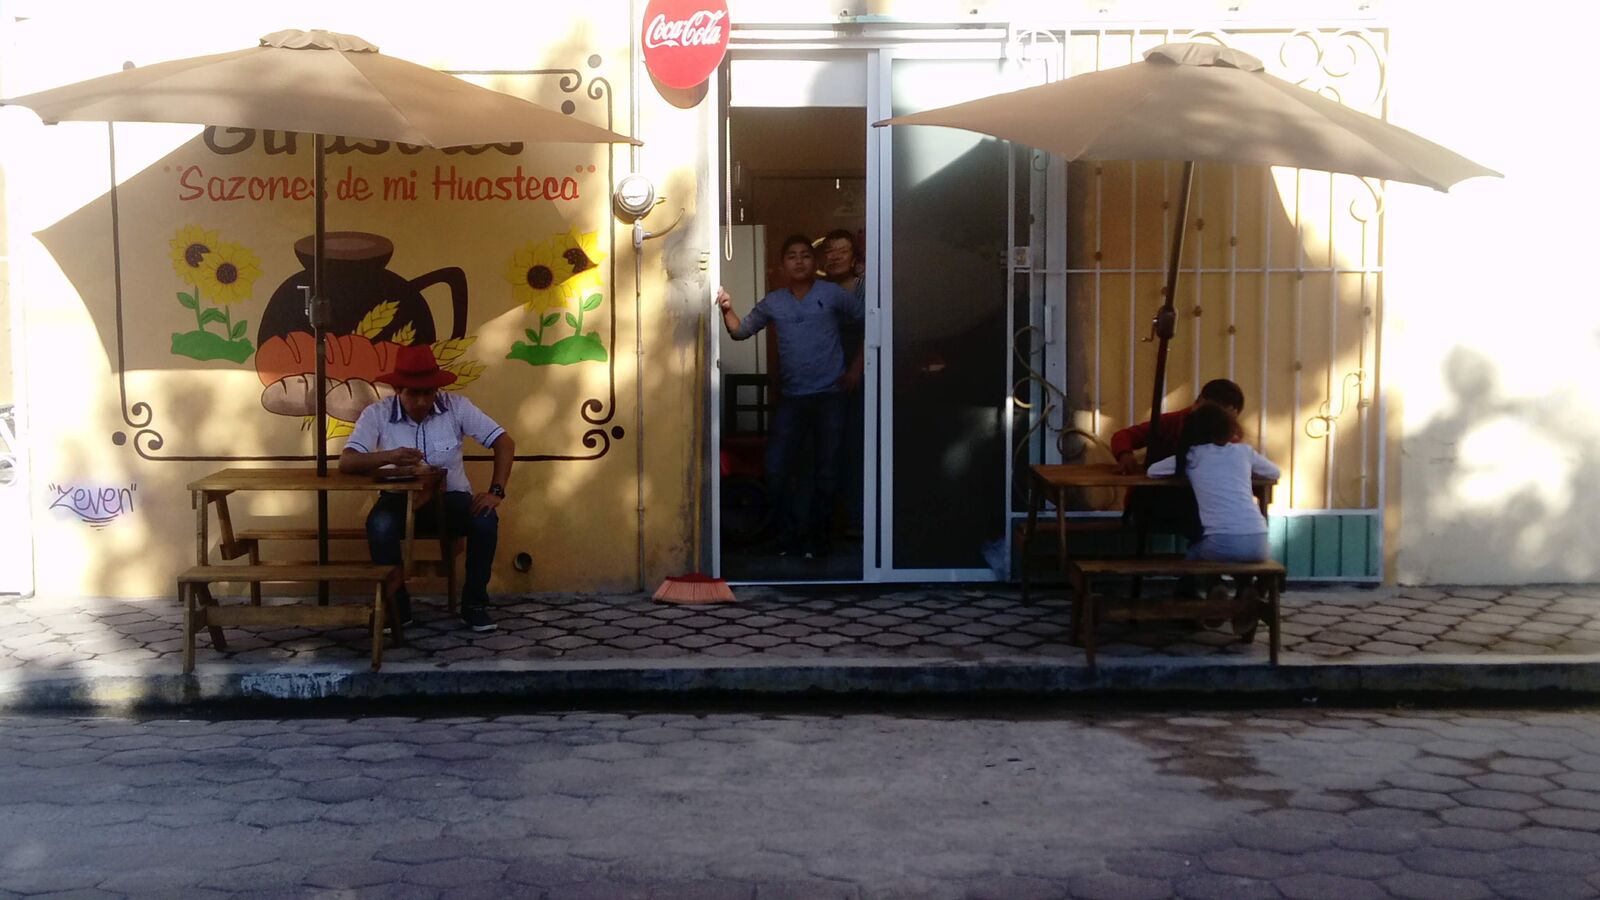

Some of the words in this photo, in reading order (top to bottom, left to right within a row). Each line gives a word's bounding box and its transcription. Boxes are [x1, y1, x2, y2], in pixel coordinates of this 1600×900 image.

[645, 10, 726, 48] Coca-Cola
[336, 166, 373, 201] de
[384, 170, 417, 201] mi
